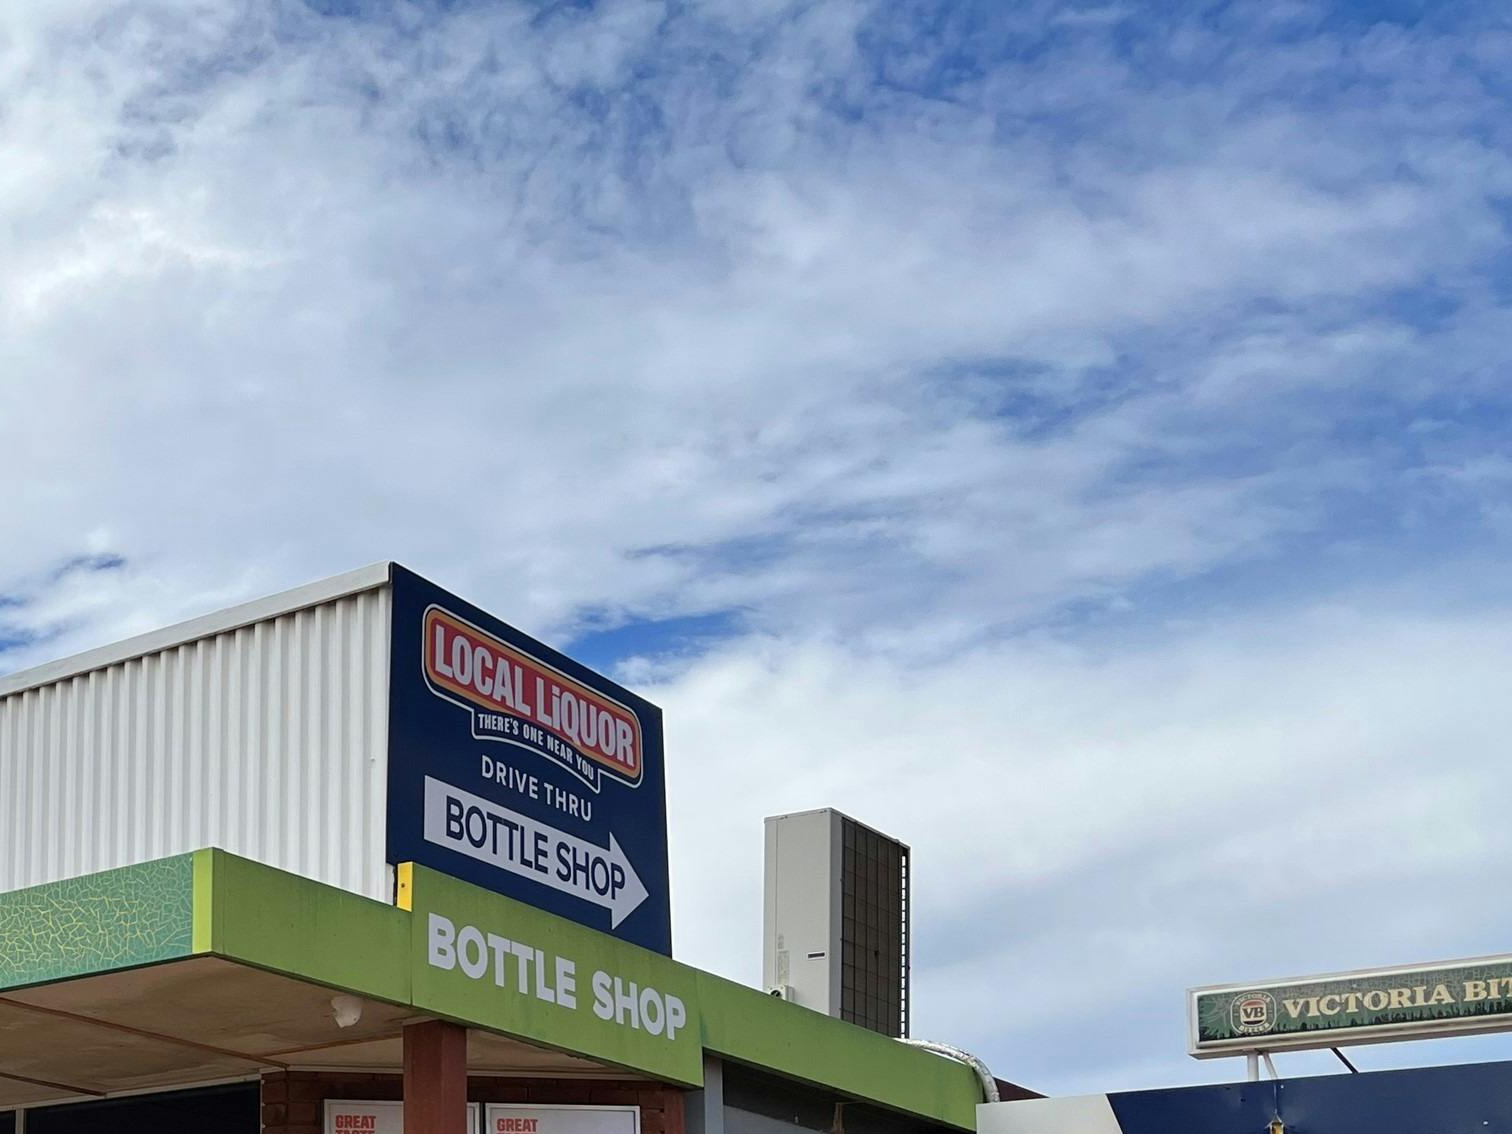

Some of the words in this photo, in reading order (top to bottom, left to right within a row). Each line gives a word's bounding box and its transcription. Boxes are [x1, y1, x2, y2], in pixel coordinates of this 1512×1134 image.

[435, 624, 531, 717] LOCAL
[478, 713, 519, 736] THERE'S
[523, 724, 544, 746] ONE
[547, 735, 573, 764] NEAR
[575, 754, 594, 781] YOU
[481, 755, 538, 799] DRIVE
[544, 783, 592, 822] THRU
[446, 795, 549, 875] BOTTLE
[555, 841, 626, 900] SHOP
[428, 912, 577, 1010] BOTTLE
[592, 970, 687, 1041] SHOP
[1283, 984, 1455, 1019] VICTORIA
[1241, 1007, 1264, 1019] VB
[335, 1115, 376, 1129] GREAT
[497, 1119, 538, 1132] GREAT
